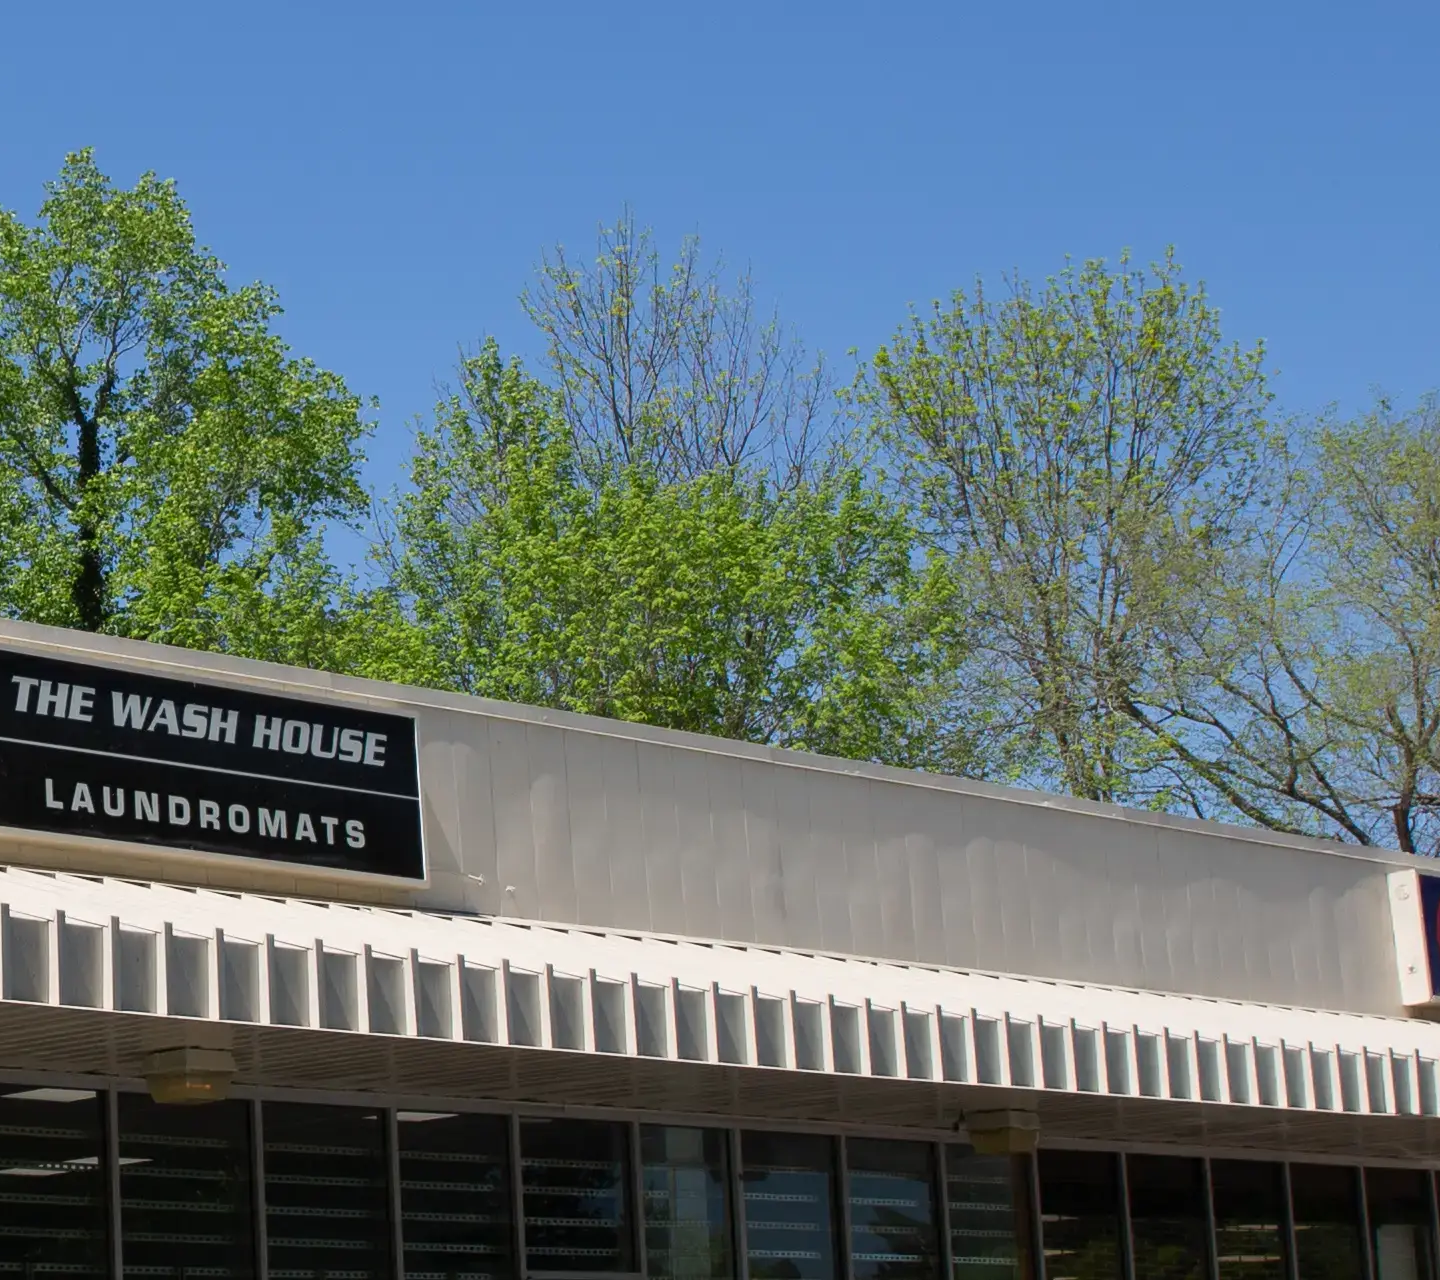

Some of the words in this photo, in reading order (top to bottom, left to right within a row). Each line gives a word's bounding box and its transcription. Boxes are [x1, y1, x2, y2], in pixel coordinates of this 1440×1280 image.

[10, 675, 97, 723] THE
[110, 690, 240, 745] WASH
[252, 714, 388, 768] HOUSE
[44, 777, 366, 850] LAUNDROMATS
